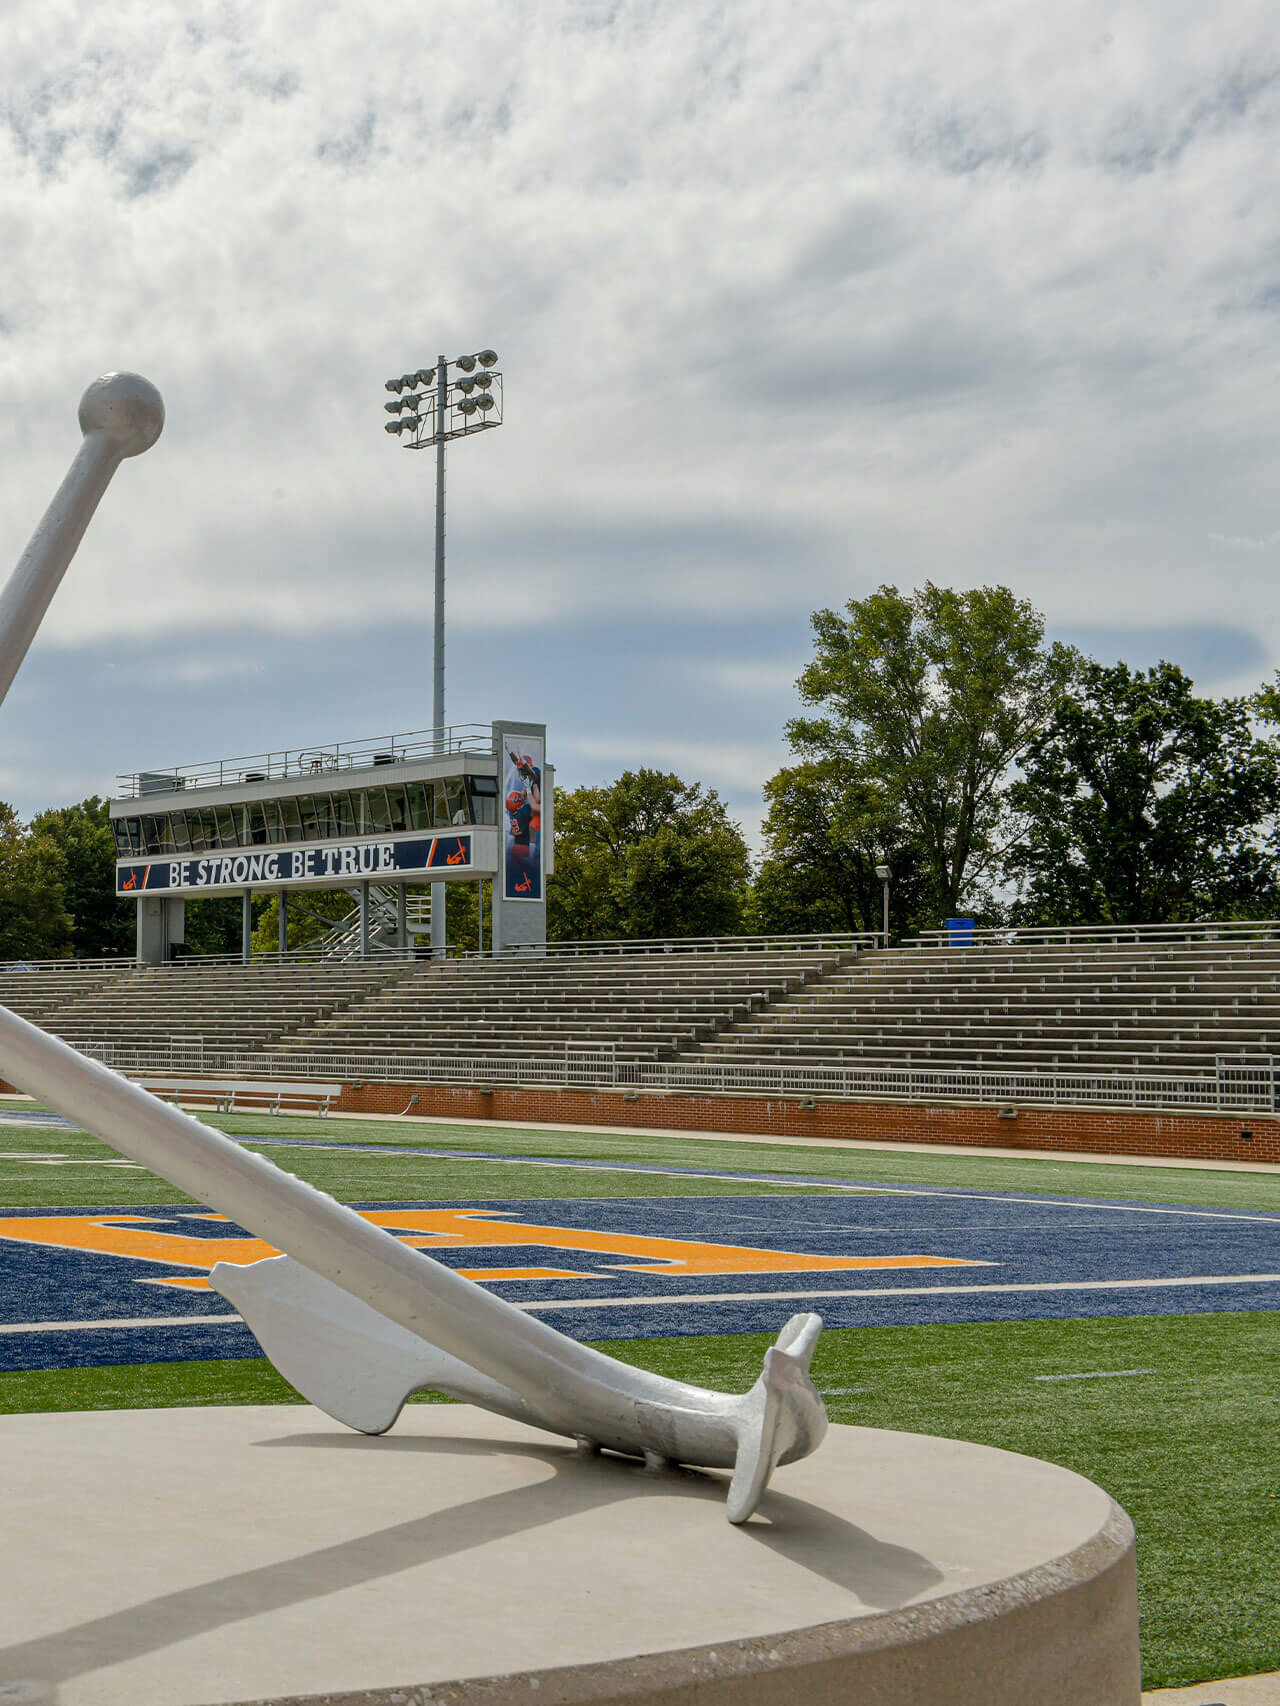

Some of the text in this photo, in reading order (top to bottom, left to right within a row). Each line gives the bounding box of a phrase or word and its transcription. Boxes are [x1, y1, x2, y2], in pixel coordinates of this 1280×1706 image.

[169, 843, 400, 888] BE STRONG. BE TRUE.
